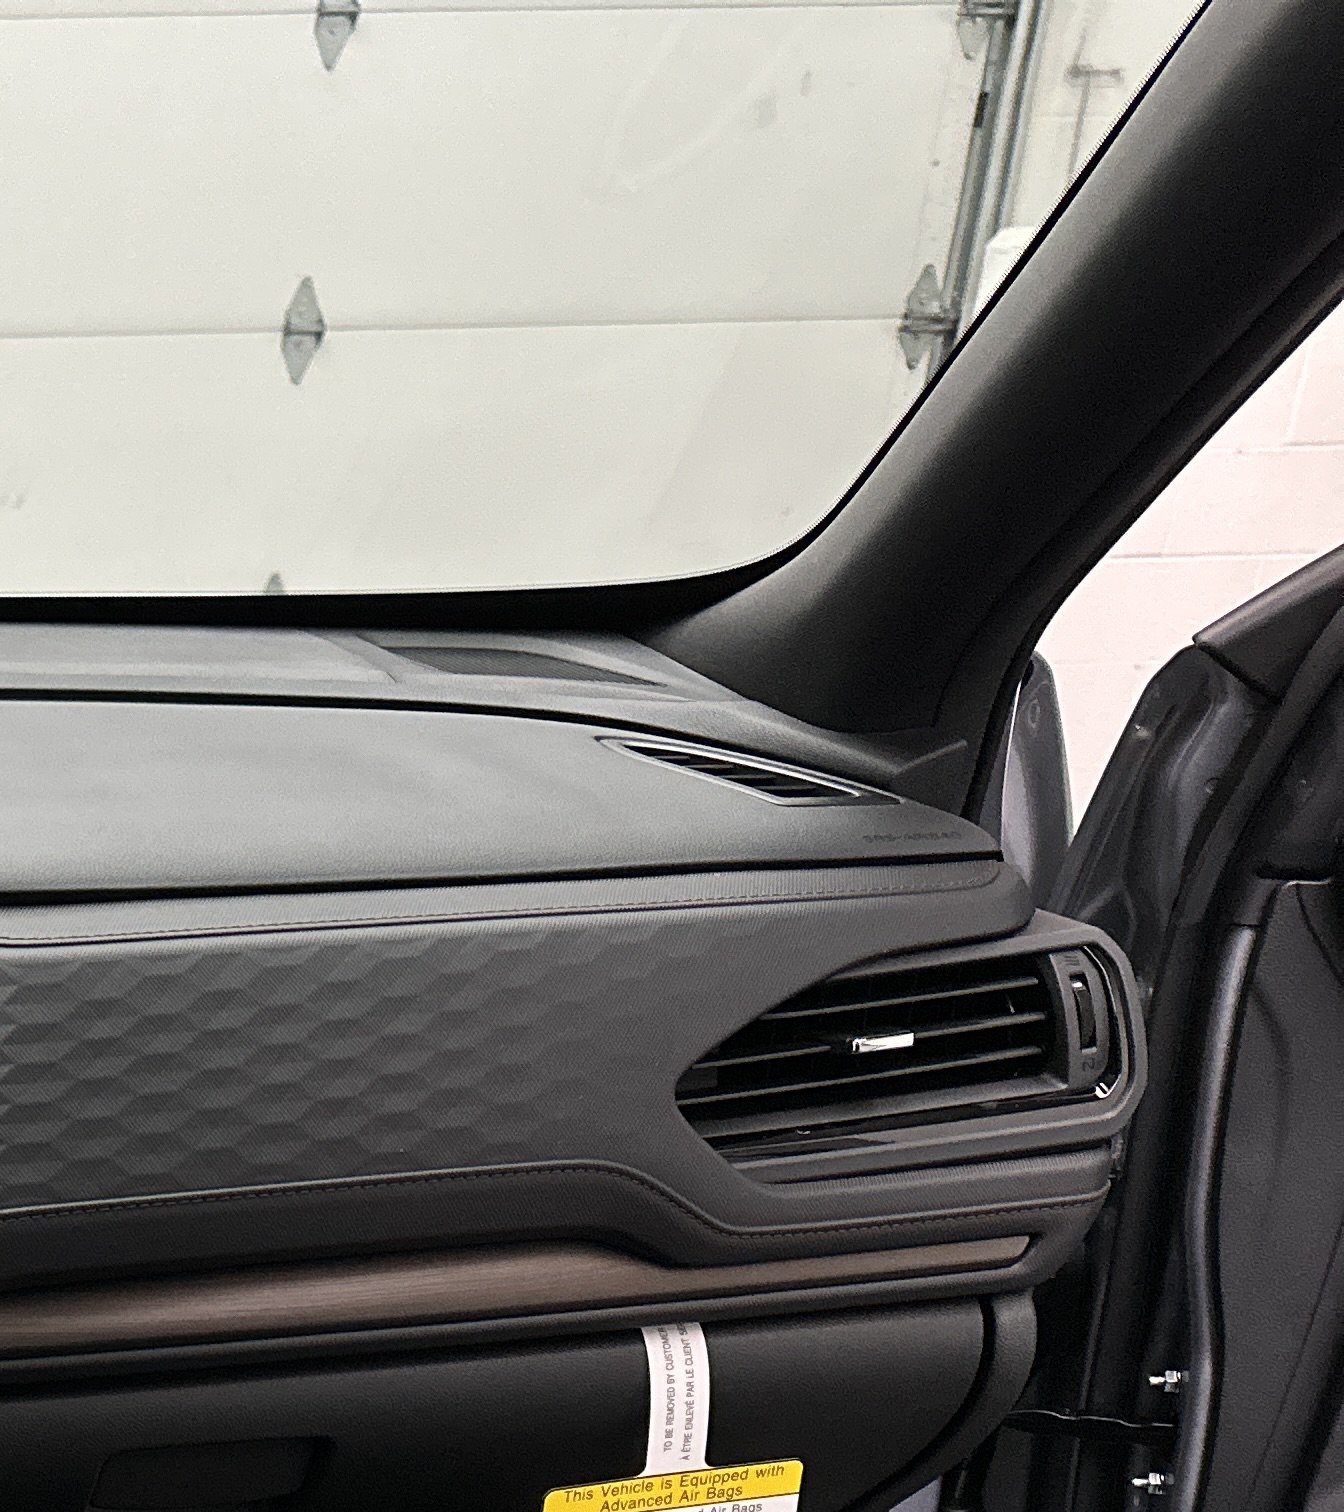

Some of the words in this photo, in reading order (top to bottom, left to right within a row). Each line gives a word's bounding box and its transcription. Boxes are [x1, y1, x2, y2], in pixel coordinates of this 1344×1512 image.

[681, 1338, 694, 1366] CLIENT
[666, 1373, 676, 1385] BY
[685, 1367, 695, 1379] LE
[685, 1381, 695, 1398] PAR
[665, 1386, 676, 1426] REMOVED
[664, 1428, 674, 1439] BE
[663, 1440, 673, 1453] TO
[564, 1488, 593, 1502] This
[601, 1480, 653, 1497] Vehicle
[661, 1477, 672, 1490] is
[679, 1468, 748, 1488] Equipped
[756, 1464, 784, 1478] with
[600, 1492, 672, 1512] Advanced
[678, 1489, 698, 1506] Air
[706, 1486, 742, 1502] Bags
